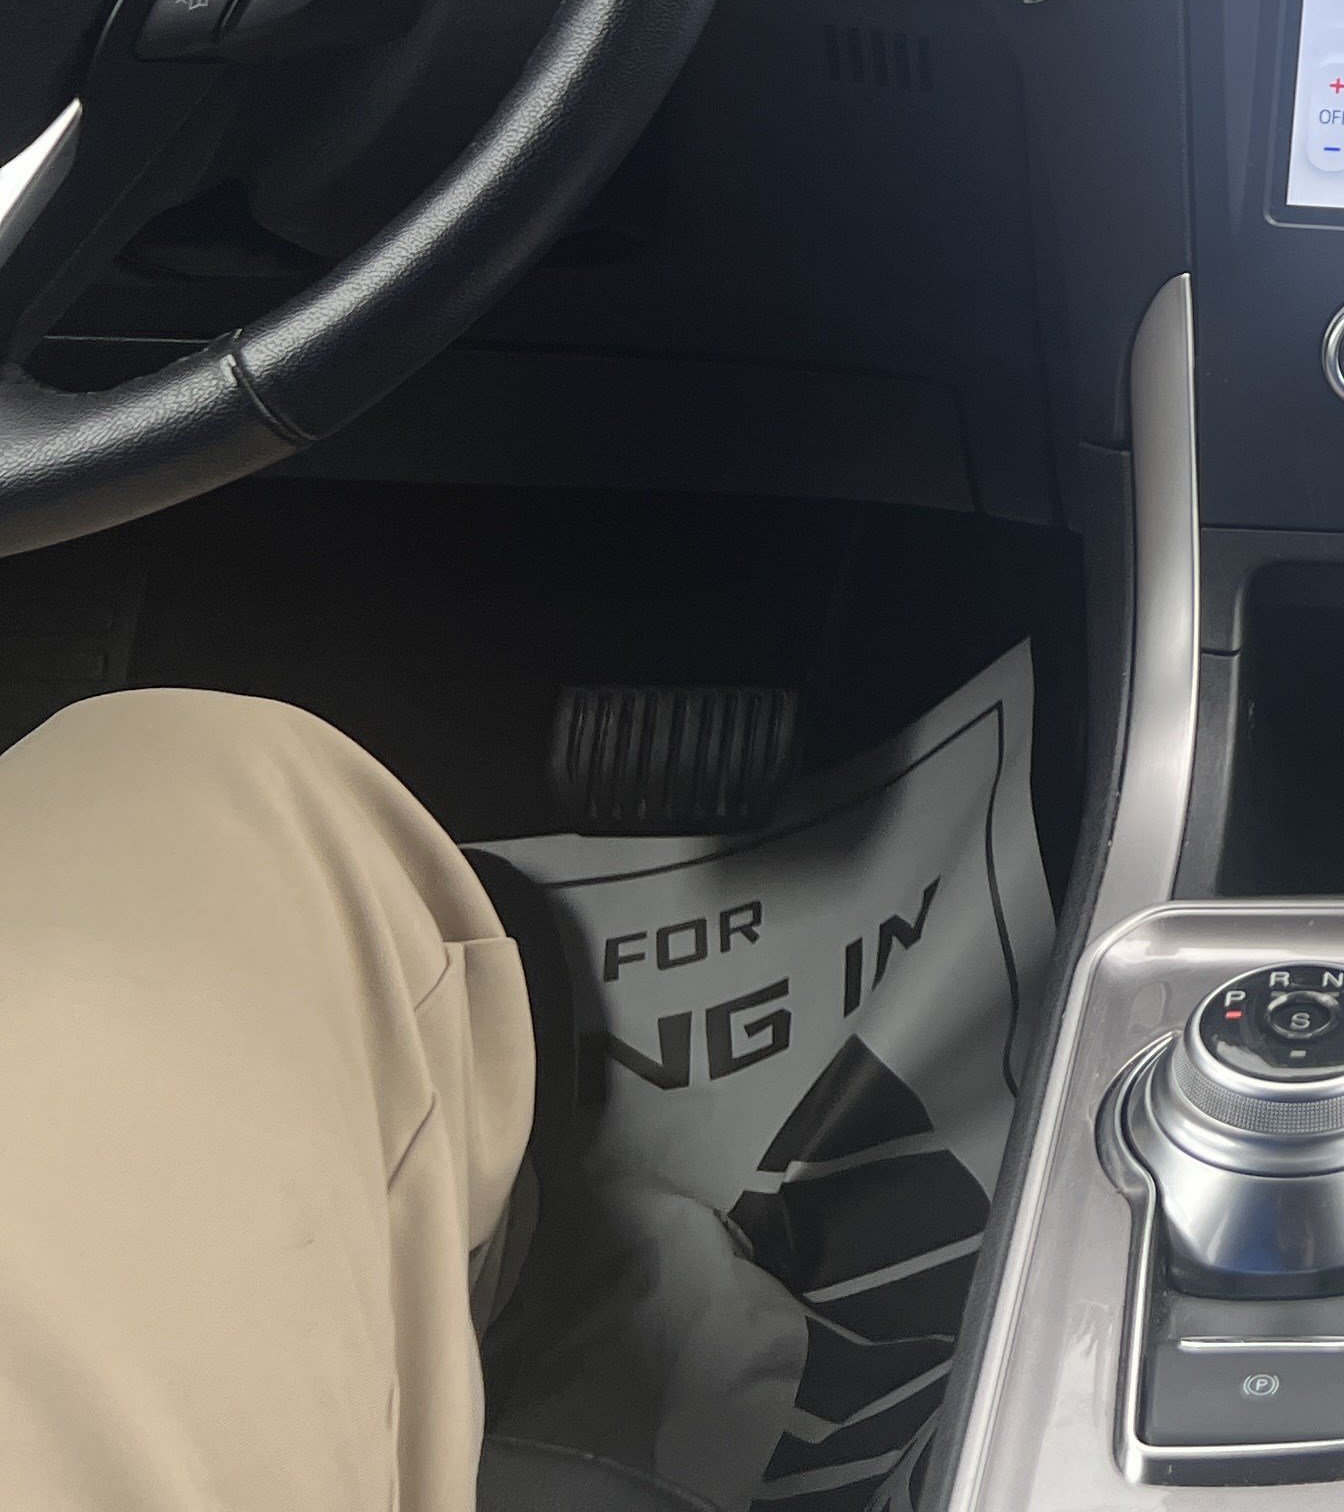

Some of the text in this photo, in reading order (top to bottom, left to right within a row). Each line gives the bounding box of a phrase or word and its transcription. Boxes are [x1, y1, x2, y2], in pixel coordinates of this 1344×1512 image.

[603, 900, 763, 983] FOR
[842, 874, 942, 1019] IN
[1269, 971, 1291, 987] R
[1322, 971, 1344, 988] N
[1224, 990, 1246, 1007] P
[1290, 1012, 1311, 1030] S
